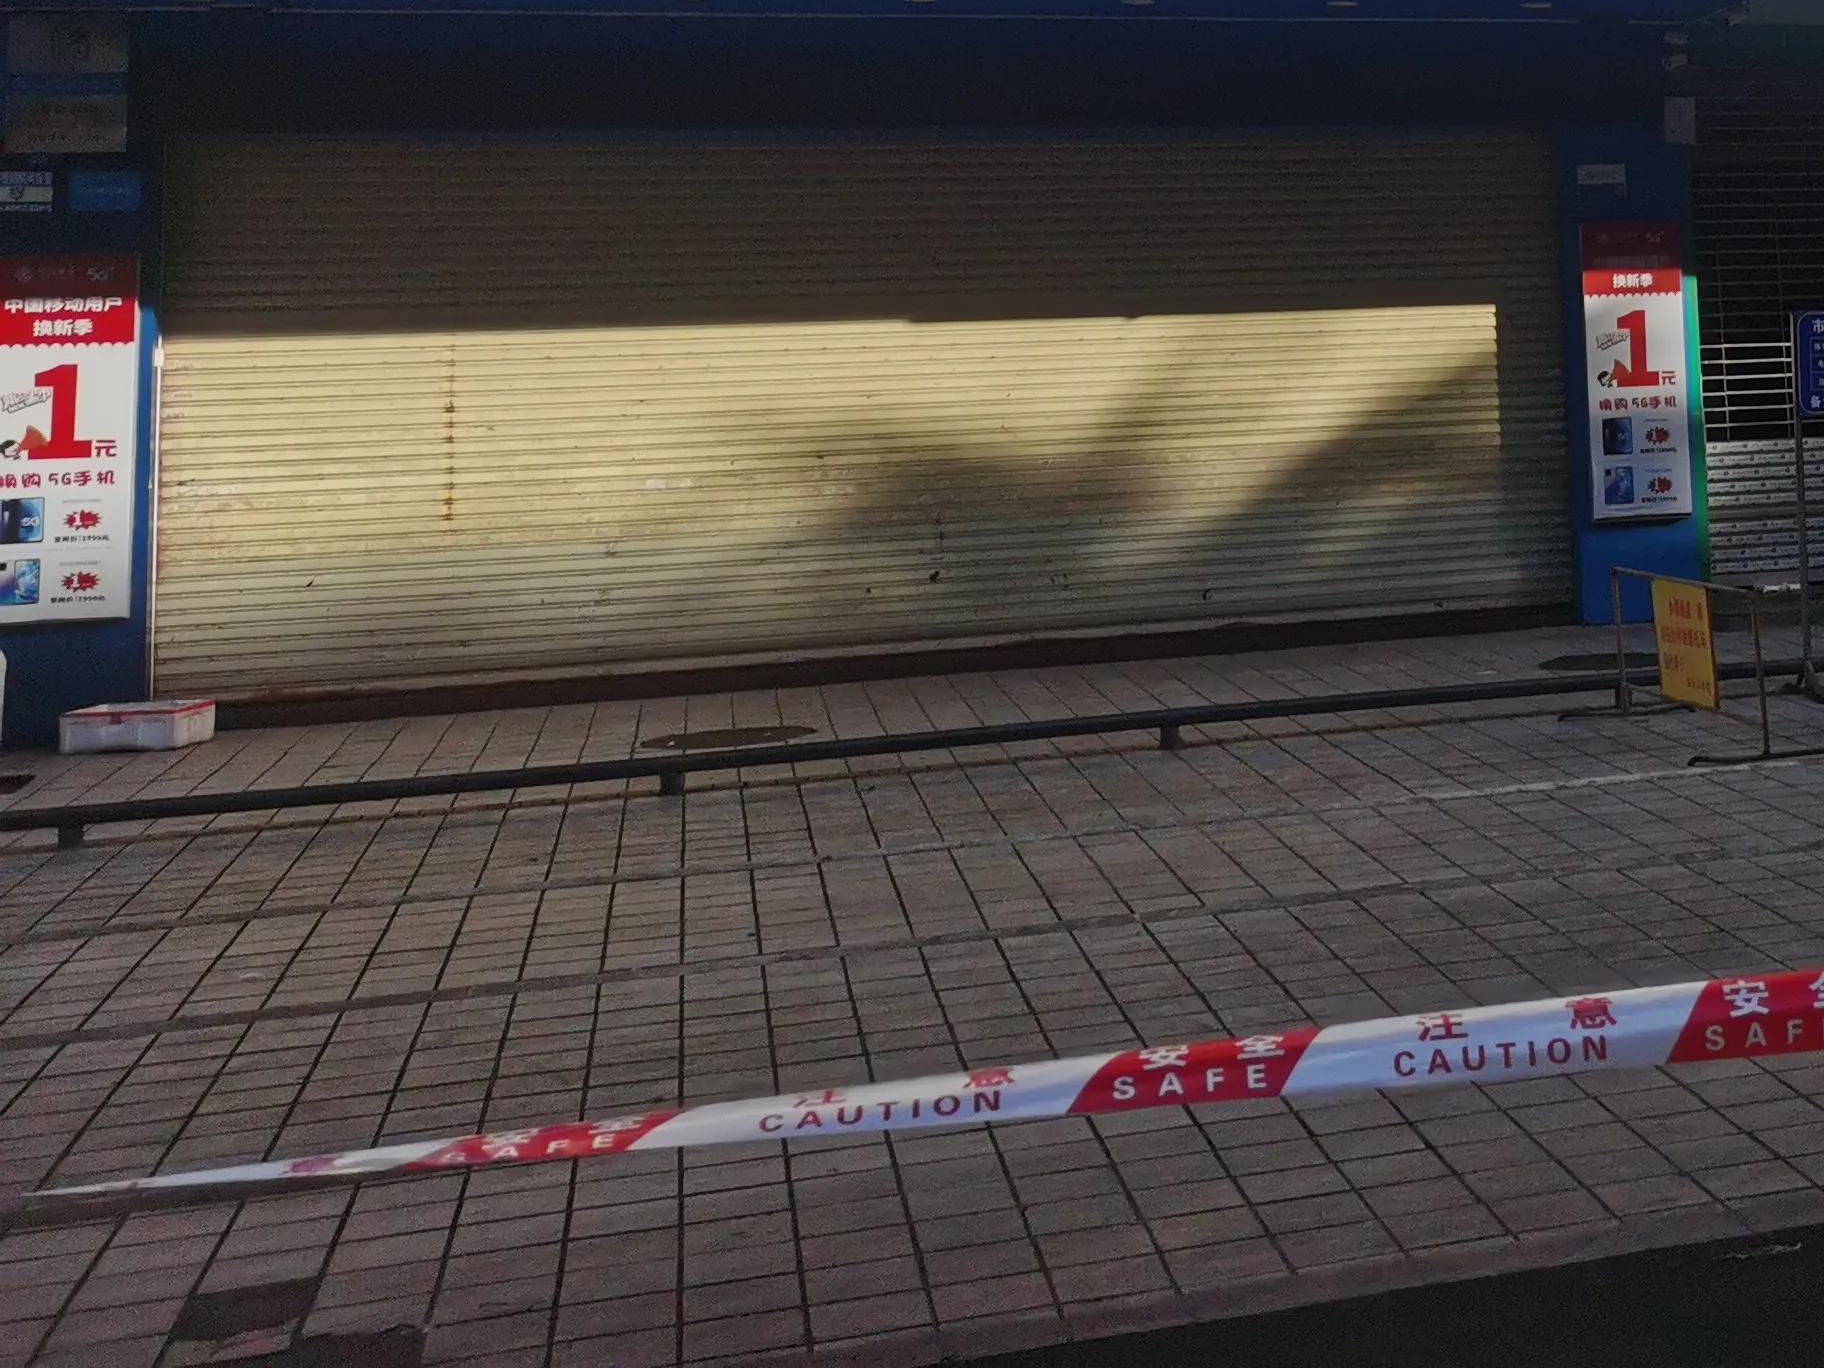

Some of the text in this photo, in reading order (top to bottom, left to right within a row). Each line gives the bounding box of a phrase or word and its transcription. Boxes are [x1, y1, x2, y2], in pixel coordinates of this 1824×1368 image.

[1418, 997, 1616, 1042] 注意
[1392, 1034, 1608, 1078] CAUTION
[1112, 1063, 1269, 1101] SAFE
[759, 1089, 1002, 1133] CAUTION
